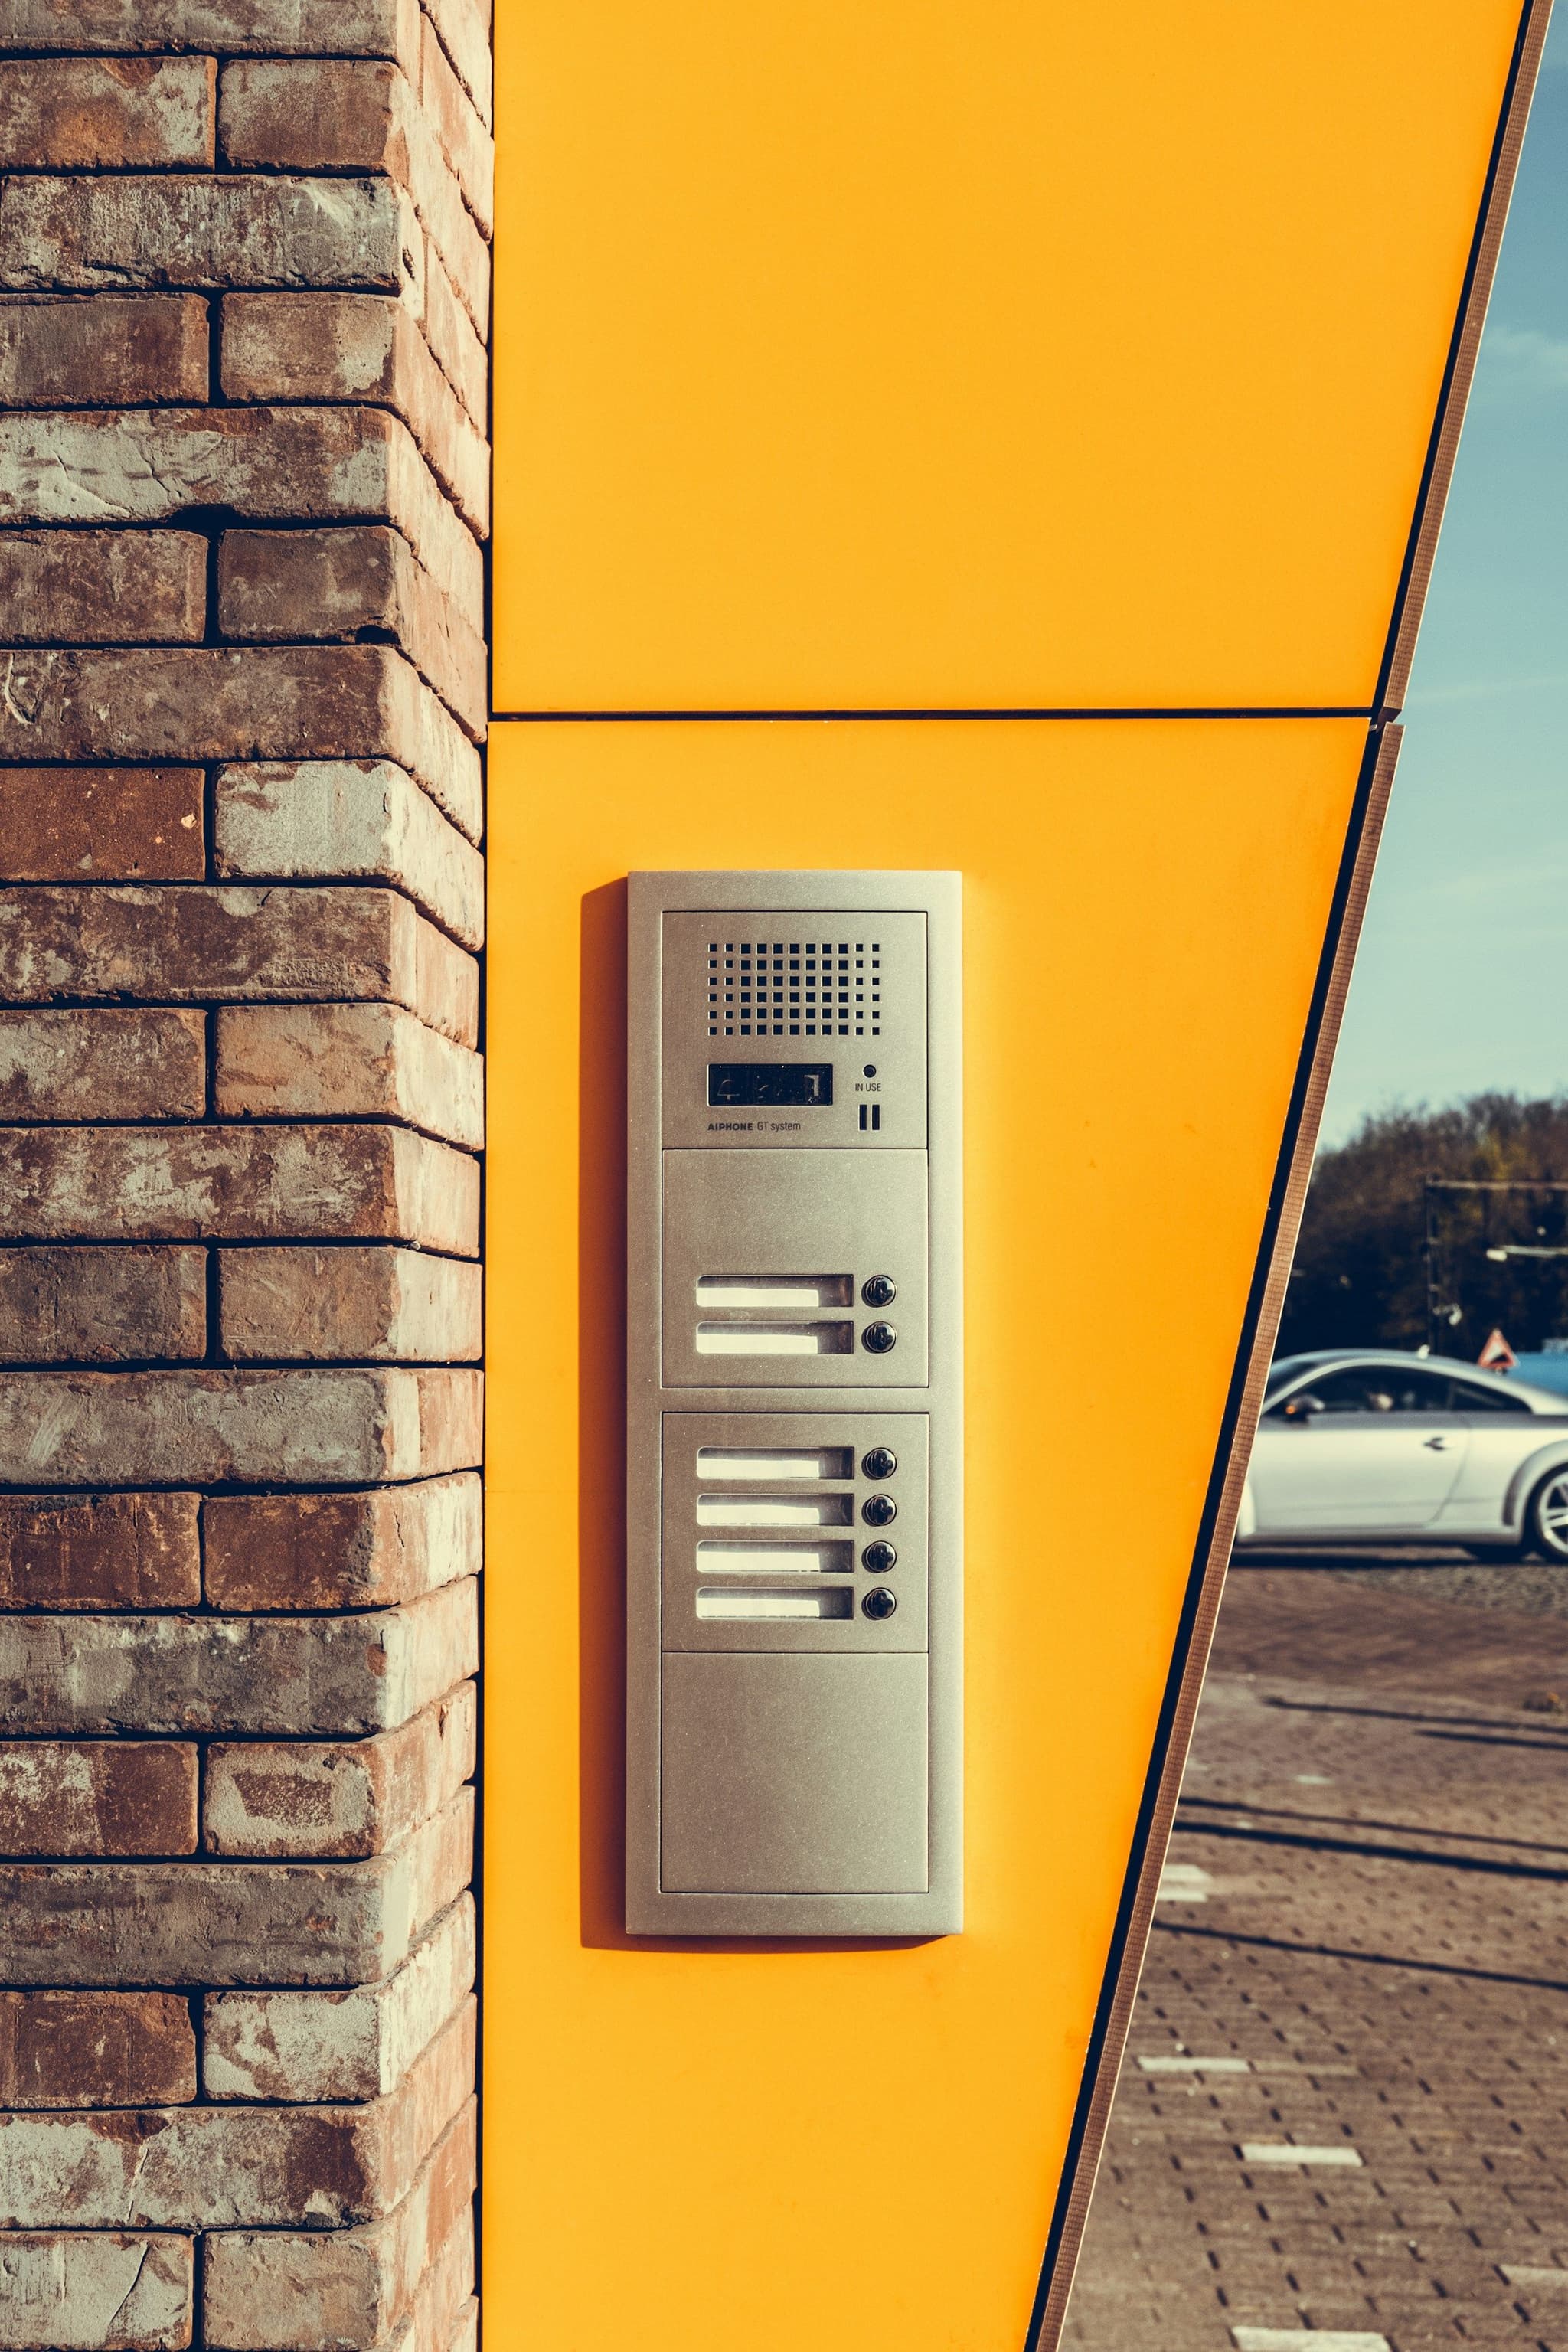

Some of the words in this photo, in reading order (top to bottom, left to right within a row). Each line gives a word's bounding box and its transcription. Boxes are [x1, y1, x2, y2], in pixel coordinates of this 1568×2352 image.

[854, 1083, 864, 1092] IN
[865, 1083, 882, 1092] USE
[707, 1122, 753, 1131] AIPHONE
[756, 1121, 769, 1131] GT
[770, 1121, 801, 1132] system
